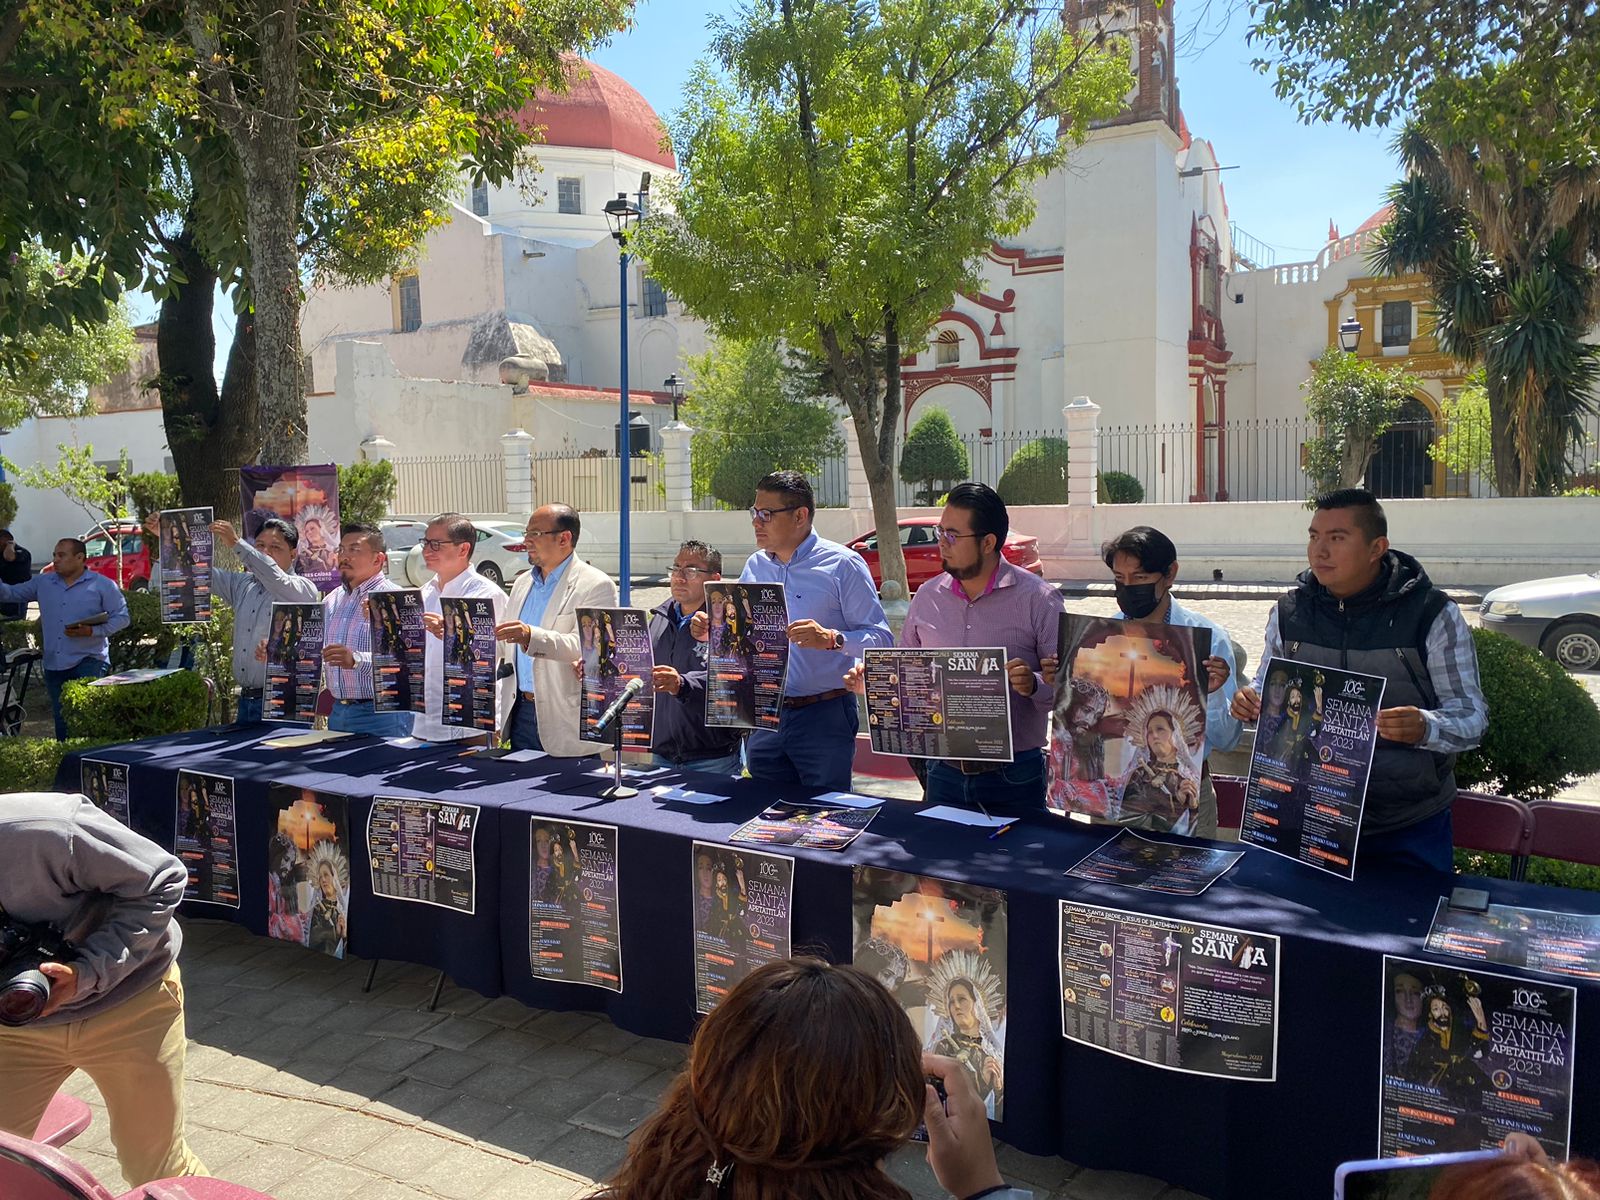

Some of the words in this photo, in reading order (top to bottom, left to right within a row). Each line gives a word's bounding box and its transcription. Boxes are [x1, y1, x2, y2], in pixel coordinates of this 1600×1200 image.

[753, 605, 785, 614] SEMANA
[753, 615, 785, 625] SANTA
[616, 630, 648, 638] SEMANA
[616, 638, 648, 647] SANTA
[1326, 698, 1372, 718] SEMANA
[1324, 710, 1369, 732] SANTA
[1331, 736, 1354, 750] 2023
[581, 849, 613, 862] SEMANA
[581, 859, 613, 874] SANTA
[590, 879, 604, 889] 2023
[749, 880, 786, 897] SEMANA
[748, 891, 785, 911] SANTA
[1064, 905, 1086, 914] SEMANA
[1086, 909, 1104, 918] SANTA
[757, 914, 774, 926] 2023
[1200, 930, 1239, 943] SEMANA
[37, 947, 55, 957] Nikon
[1513, 989, 1540, 1008] 100
[1492, 1011, 1566, 1038] SEMANA
[1492, 1026, 1564, 1056] SANTA
[1508, 1058, 1541, 1075] 2023
